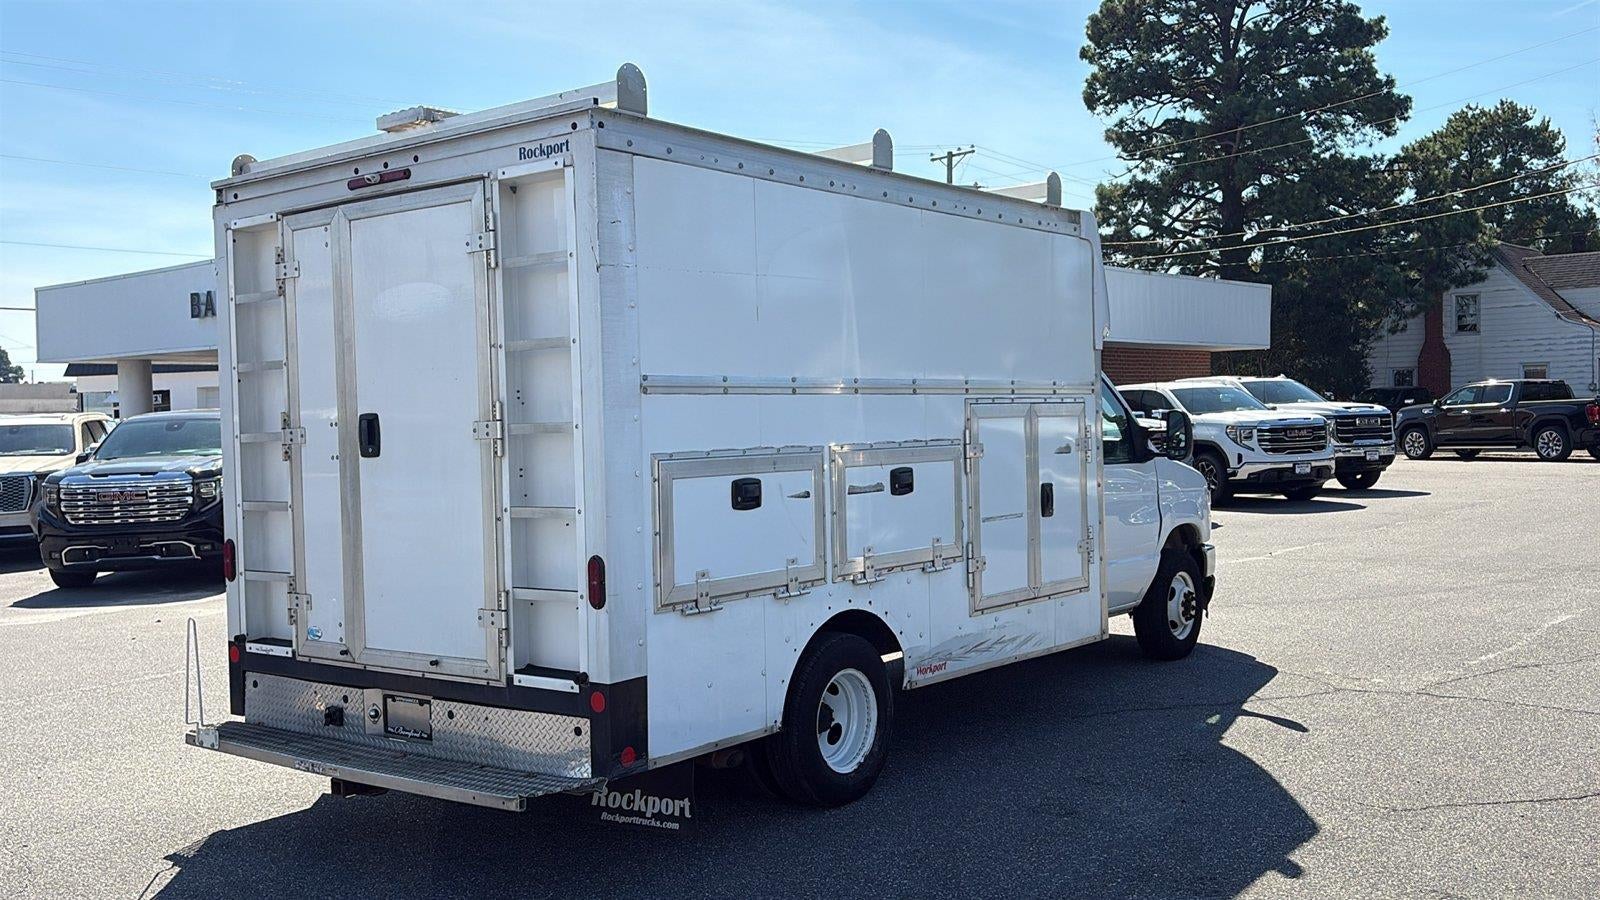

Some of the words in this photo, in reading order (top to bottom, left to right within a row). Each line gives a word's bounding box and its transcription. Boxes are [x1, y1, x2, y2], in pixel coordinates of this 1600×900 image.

[519, 139, 570, 160] Rockport
[98, 491, 146, 501] GMC
[916, 661, 947, 677] Workport
[591, 787, 692, 818] Rockport
[600, 811, 680, 830] Rockporttrucks.com
